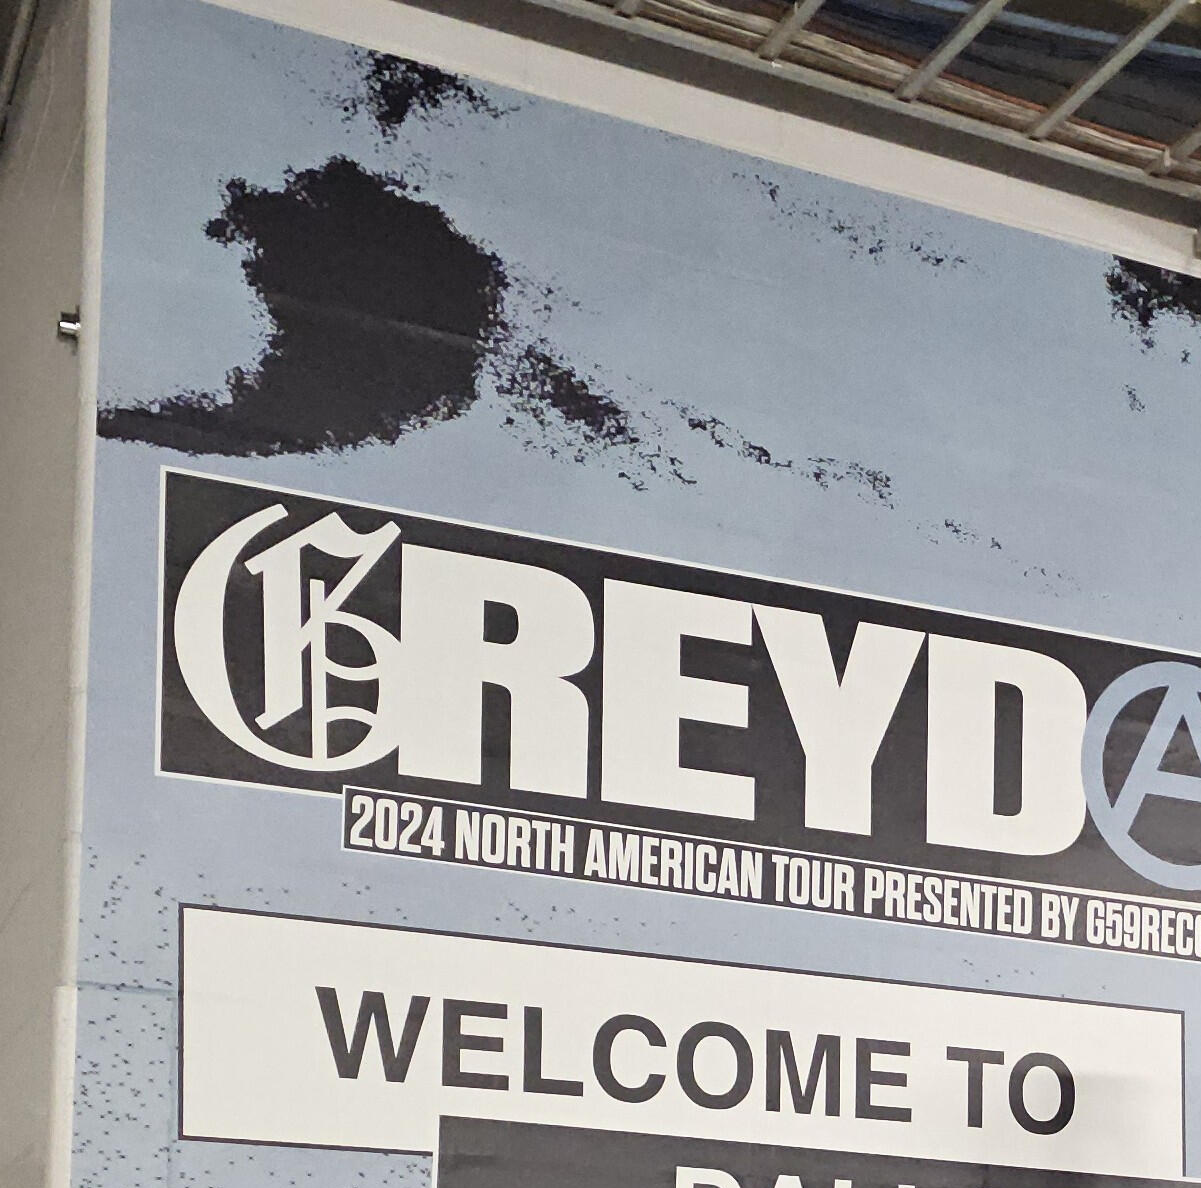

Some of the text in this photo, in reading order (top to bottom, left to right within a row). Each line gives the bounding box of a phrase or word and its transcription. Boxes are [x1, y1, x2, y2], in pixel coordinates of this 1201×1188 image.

[349, 794, 446, 857] 2024
[454, 809, 576, 874] NORTH
[583, 828, 764, 900] AMERICAN
[771, 854, 855, 912] TOUR
[864, 869, 1033, 935] PRESENTED
[1040, 895, 1080, 941] BY
[314, 985, 1077, 1136] WELCOME TO
